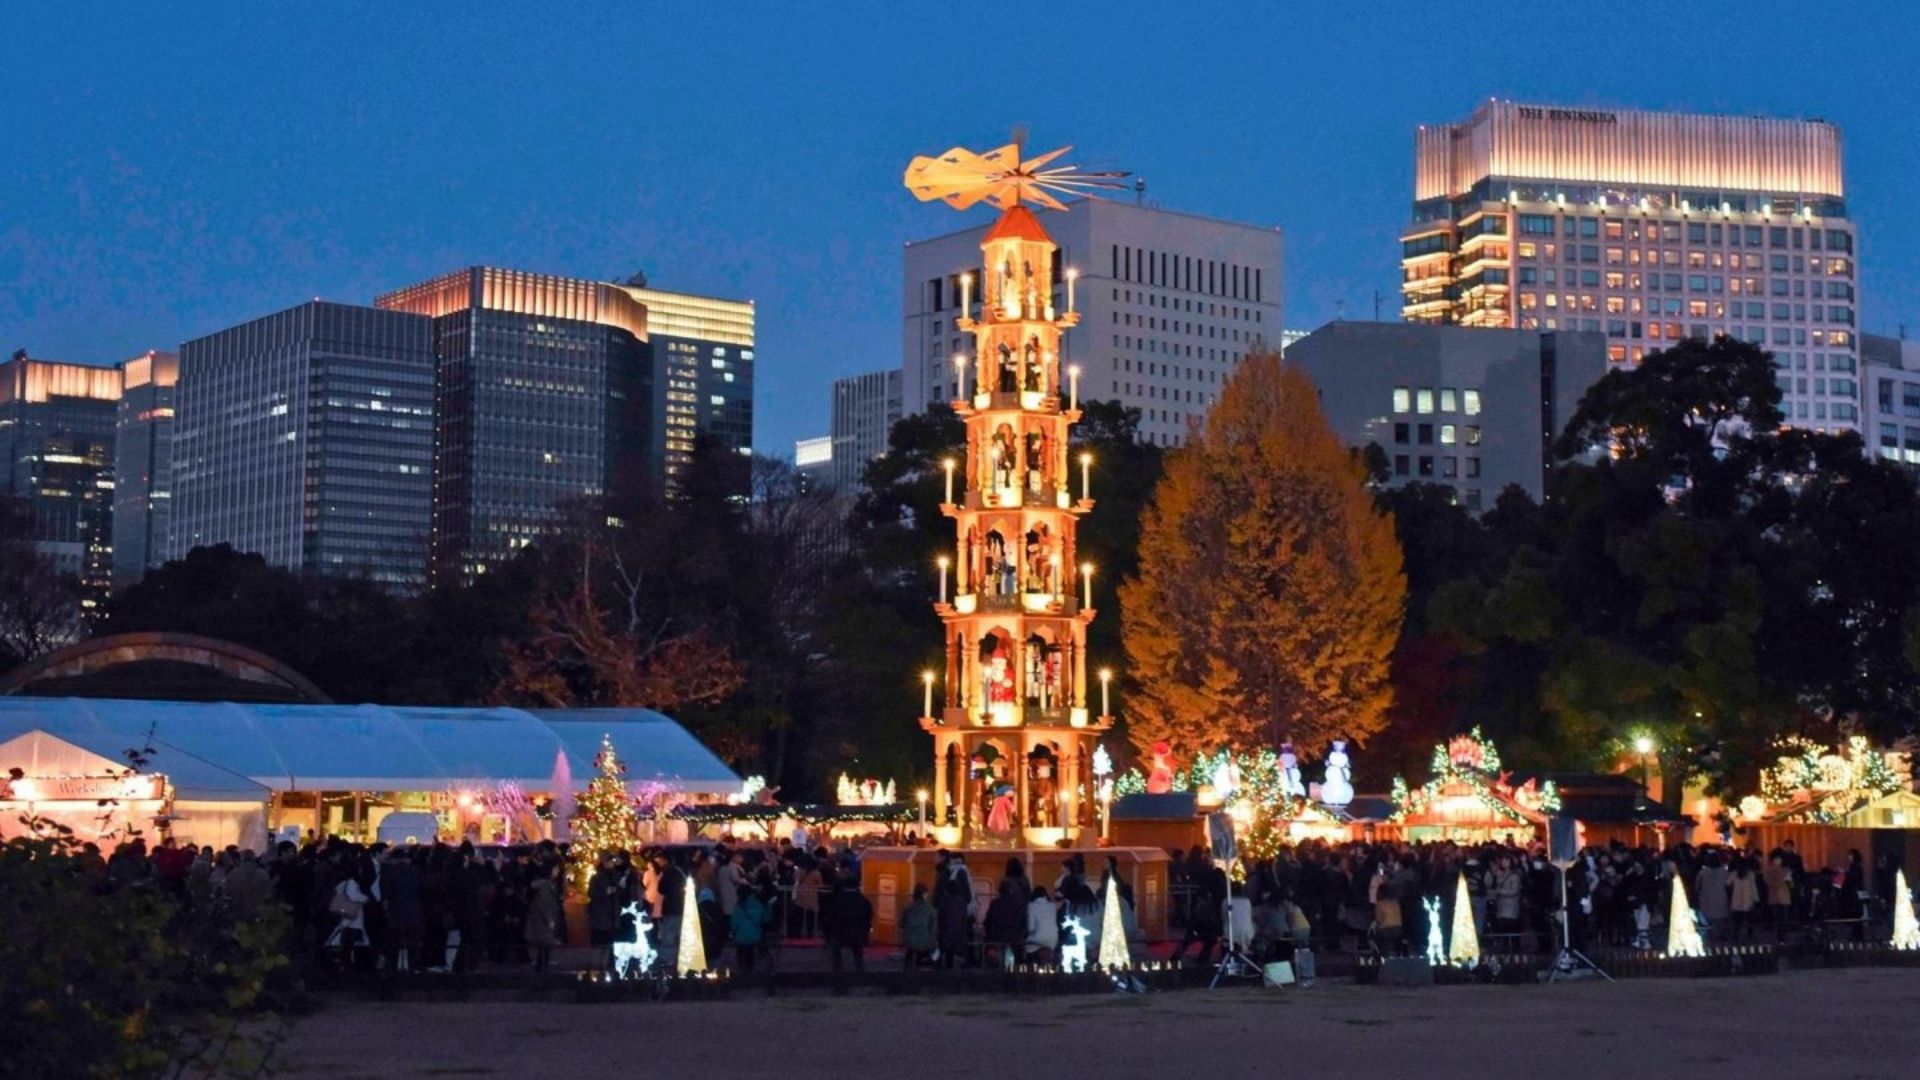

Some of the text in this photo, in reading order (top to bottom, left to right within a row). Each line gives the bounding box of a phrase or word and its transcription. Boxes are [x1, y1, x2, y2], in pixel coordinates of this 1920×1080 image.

[1519, 107, 1618, 124] THE PENINSULA
[59, 783, 114, 794] Worksh
